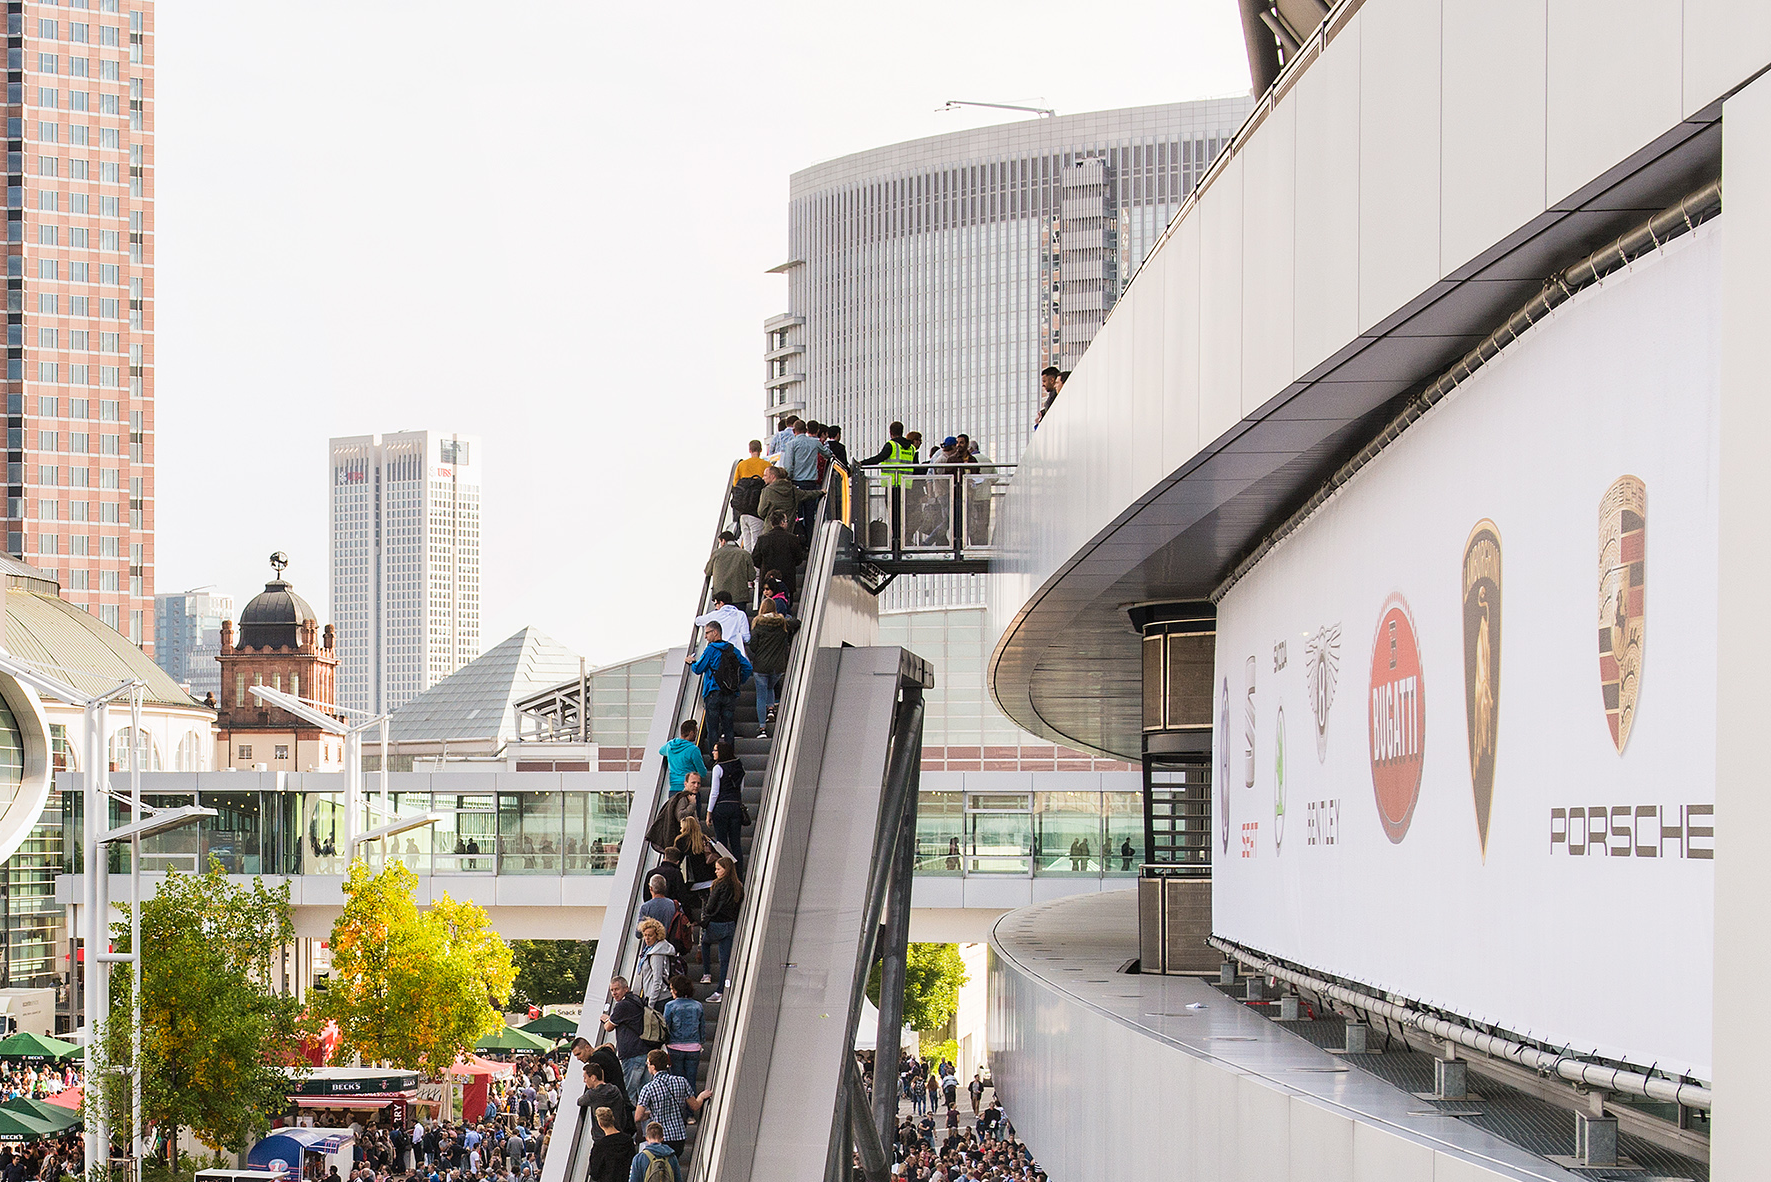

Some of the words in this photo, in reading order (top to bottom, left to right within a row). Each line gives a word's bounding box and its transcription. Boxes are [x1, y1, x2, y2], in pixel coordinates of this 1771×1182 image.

[437, 467, 452, 478] UBS
[1372, 675, 1418, 761] BUGATTI
[1241, 822, 1259, 858] SEAT
[1307, 799, 1340, 845] BENTLEY
[1550, 804, 1714, 860] PORSCHE
[331, 1082, 361, 1091] BECK'S
